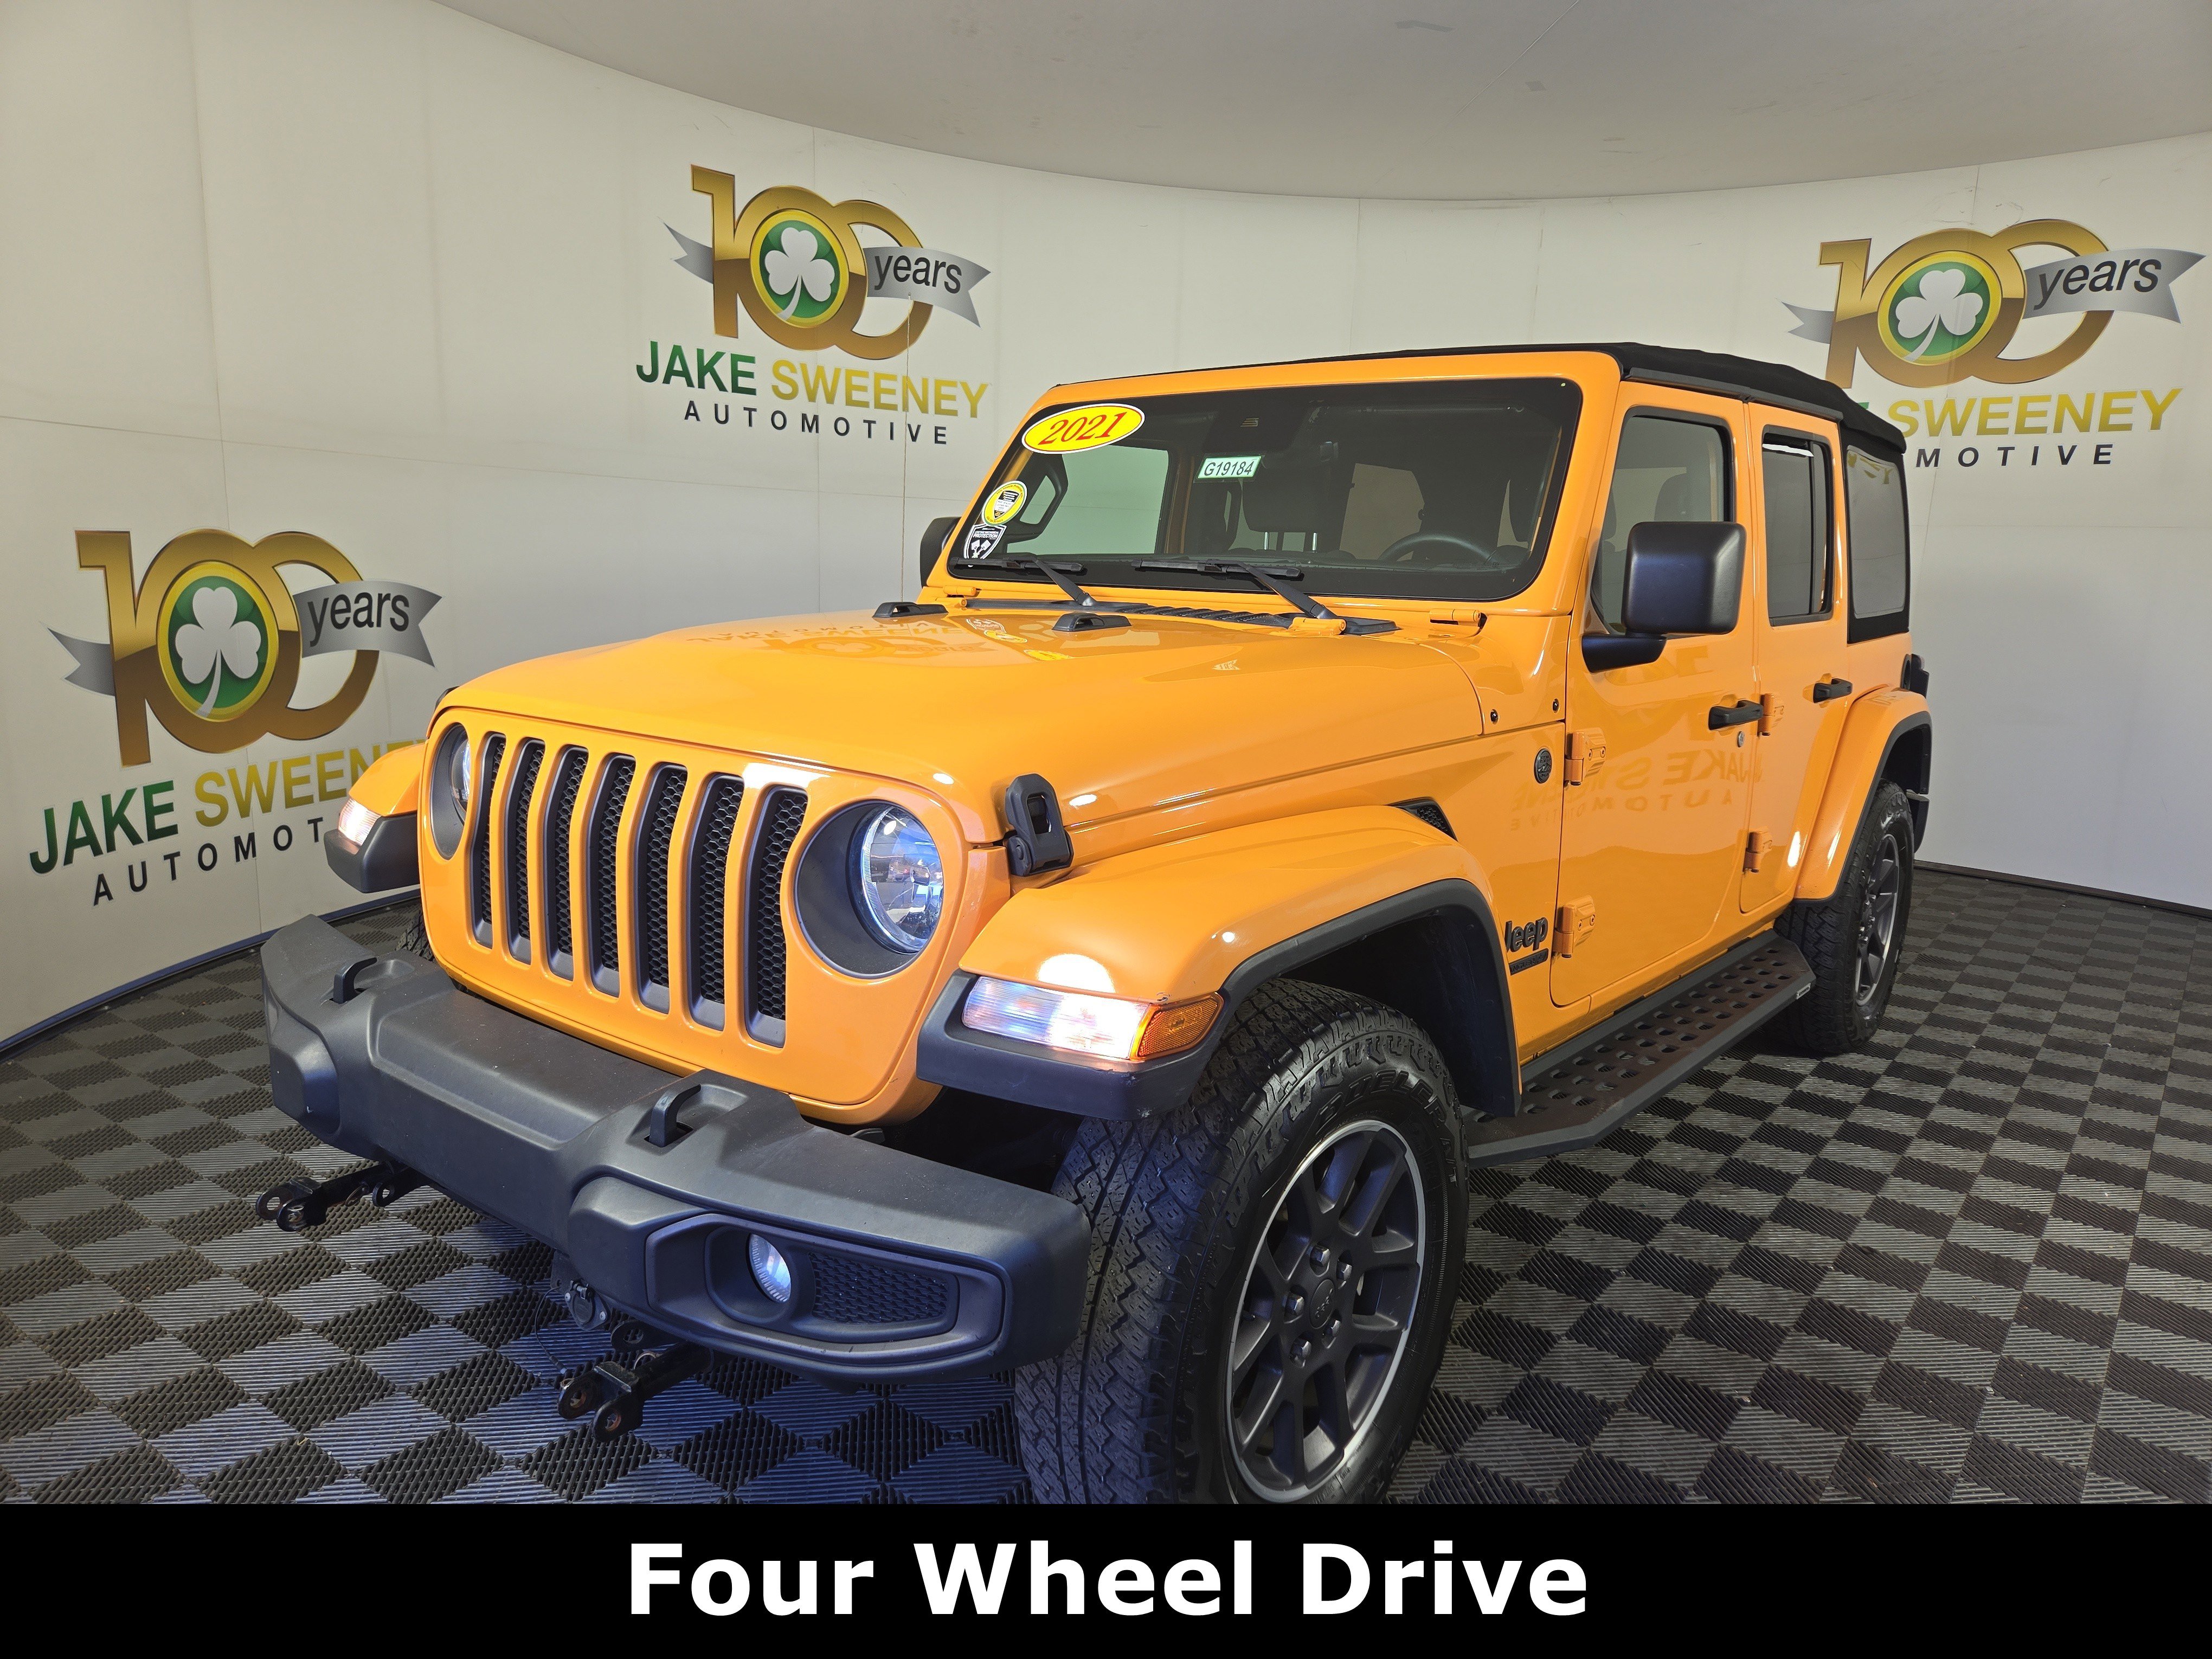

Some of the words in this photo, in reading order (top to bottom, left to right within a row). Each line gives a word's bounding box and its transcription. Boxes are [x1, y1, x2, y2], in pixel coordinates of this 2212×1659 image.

[690, 164, 933, 361] 100
[874, 253, 962, 294] years
[2033, 257, 2162, 310] years
[1819, 218, 2115, 389] 100
[636, 340, 757, 396] JAKE
[771, 359, 988, 419] SWEENEY
[684, 400, 947, 445] AUTOMOTIVE
[1038, 411, 1128, 445] 2021
[1888, 388, 2184, 438] SWEENEY
[1204, 461, 1255, 476] G19184
[1915, 443, 2114, 468] MOTIVE
[307, 591, 410, 647] years
[74, 529, 380, 768] 100
[29, 780, 179, 874] JAKE
[194, 739, 427, 828] SWEEN
[93, 816, 324, 906] AUTOMOT
[1504, 917, 1548, 953] Jeep
